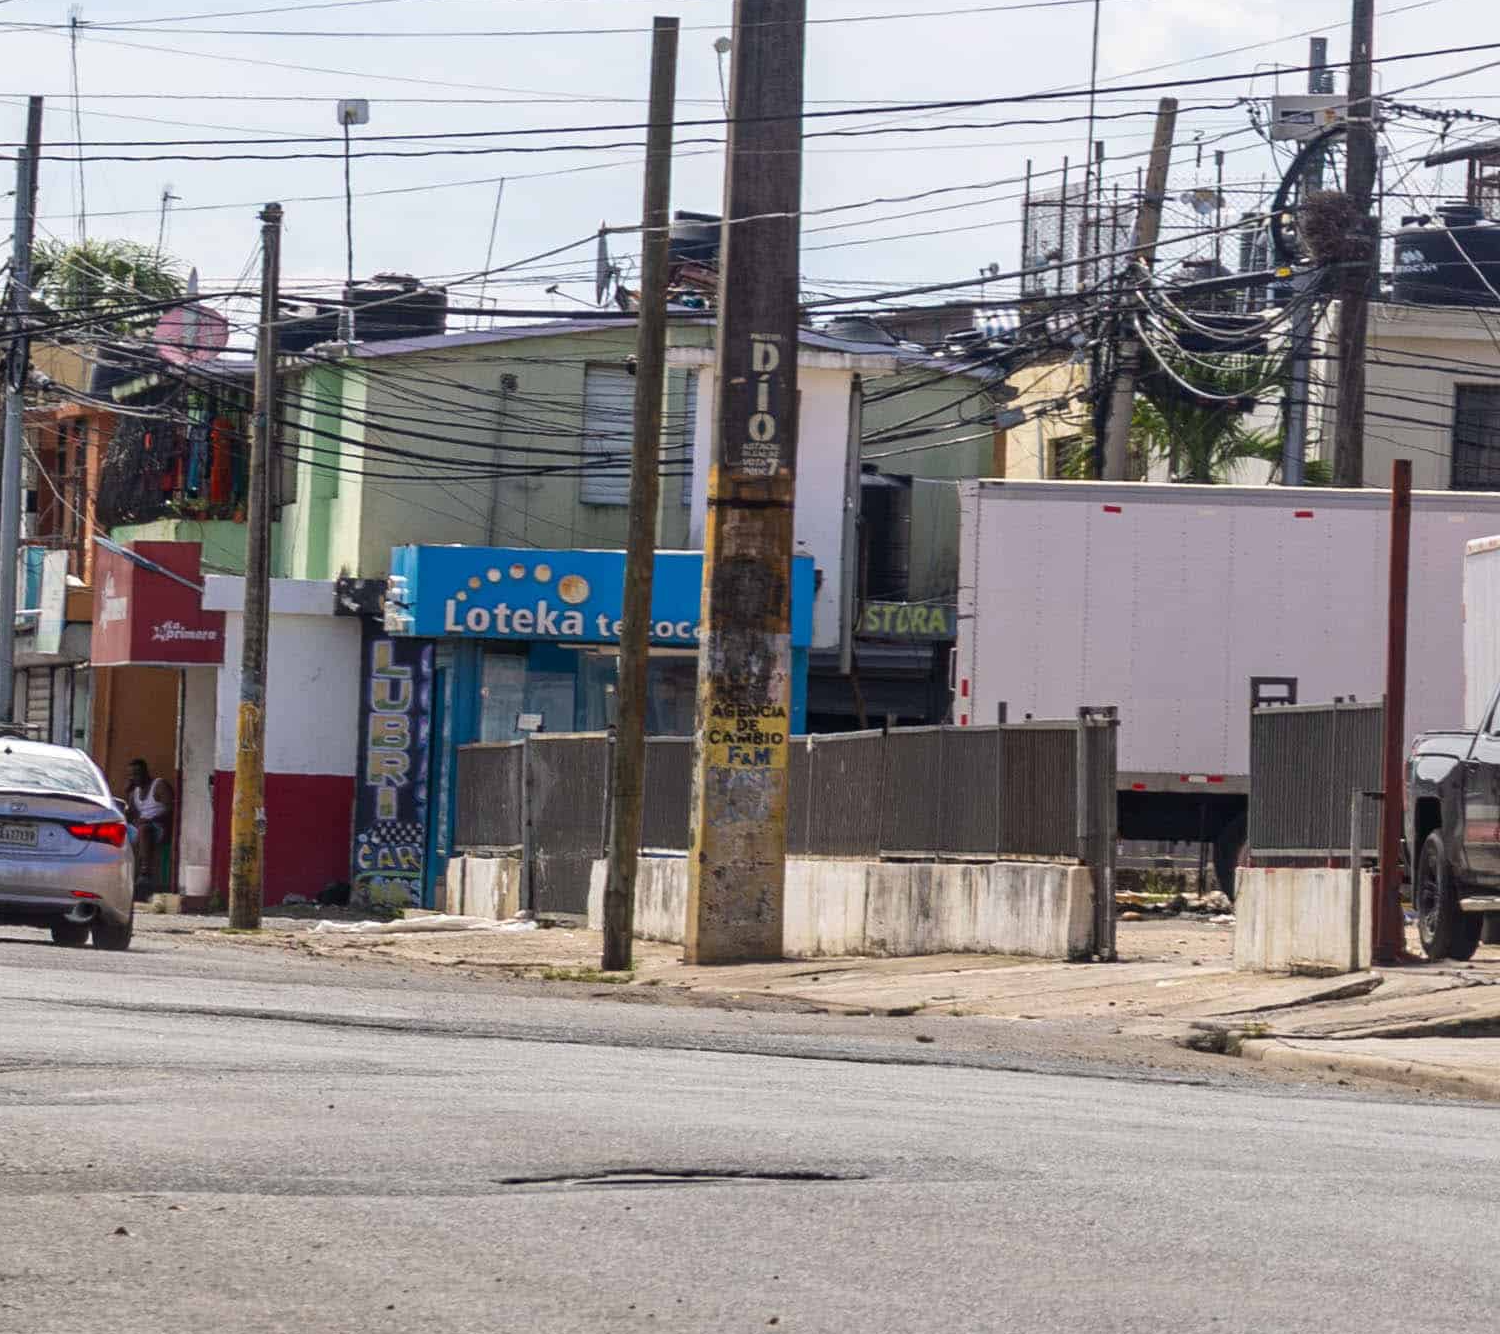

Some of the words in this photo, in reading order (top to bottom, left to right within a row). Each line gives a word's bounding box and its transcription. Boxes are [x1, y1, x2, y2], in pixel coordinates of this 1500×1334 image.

[444, 599, 584, 635] Loteka
[712, 703, 786, 718] AGENCIA
[366, 639, 413, 820] LUBRI
[736, 719, 760, 732] DE
[709, 729, 784, 745] CAMBIO
